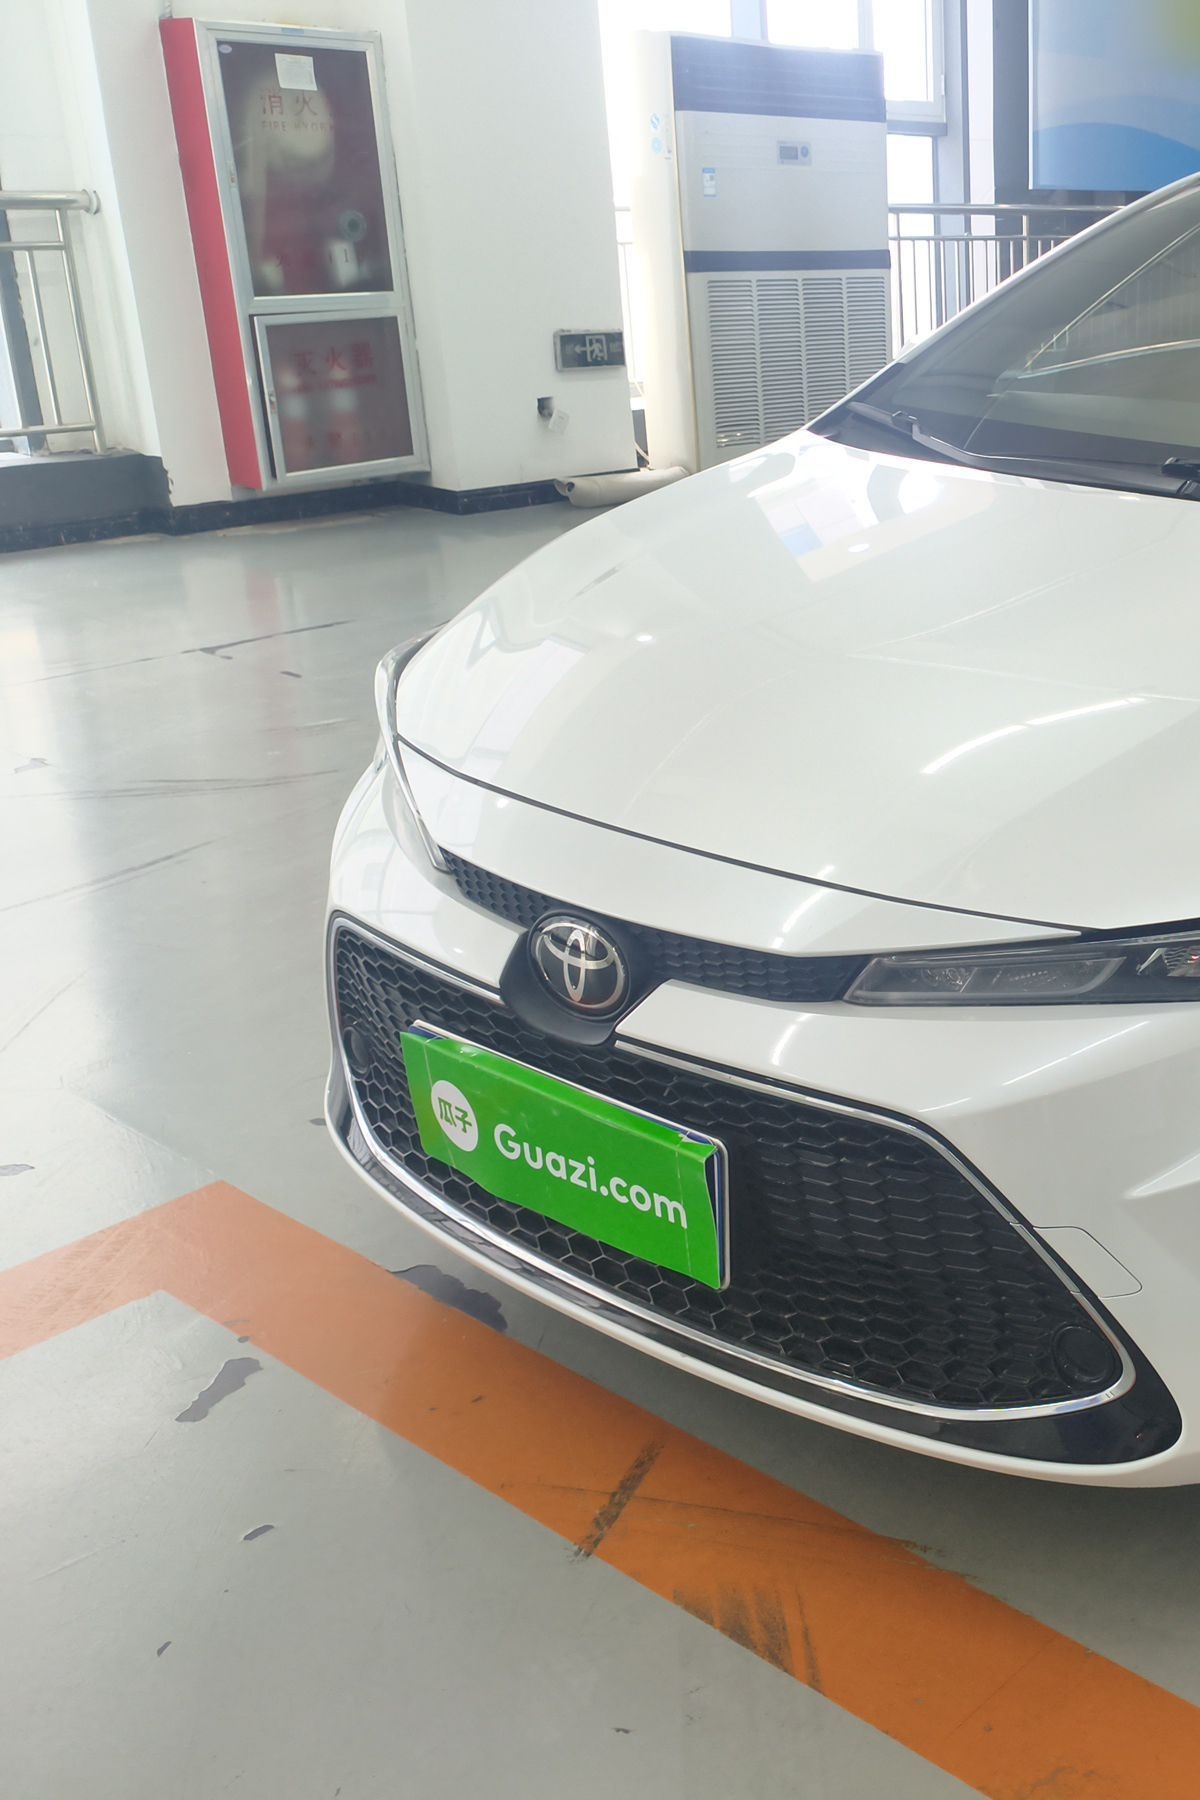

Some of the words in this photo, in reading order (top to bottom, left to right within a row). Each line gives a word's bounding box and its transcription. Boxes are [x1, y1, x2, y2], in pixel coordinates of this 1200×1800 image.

[261, 87, 333, 117] 消火
[437, 1096, 473, 1134] 瓜子
[493, 1122, 689, 1230] Guazi.com
